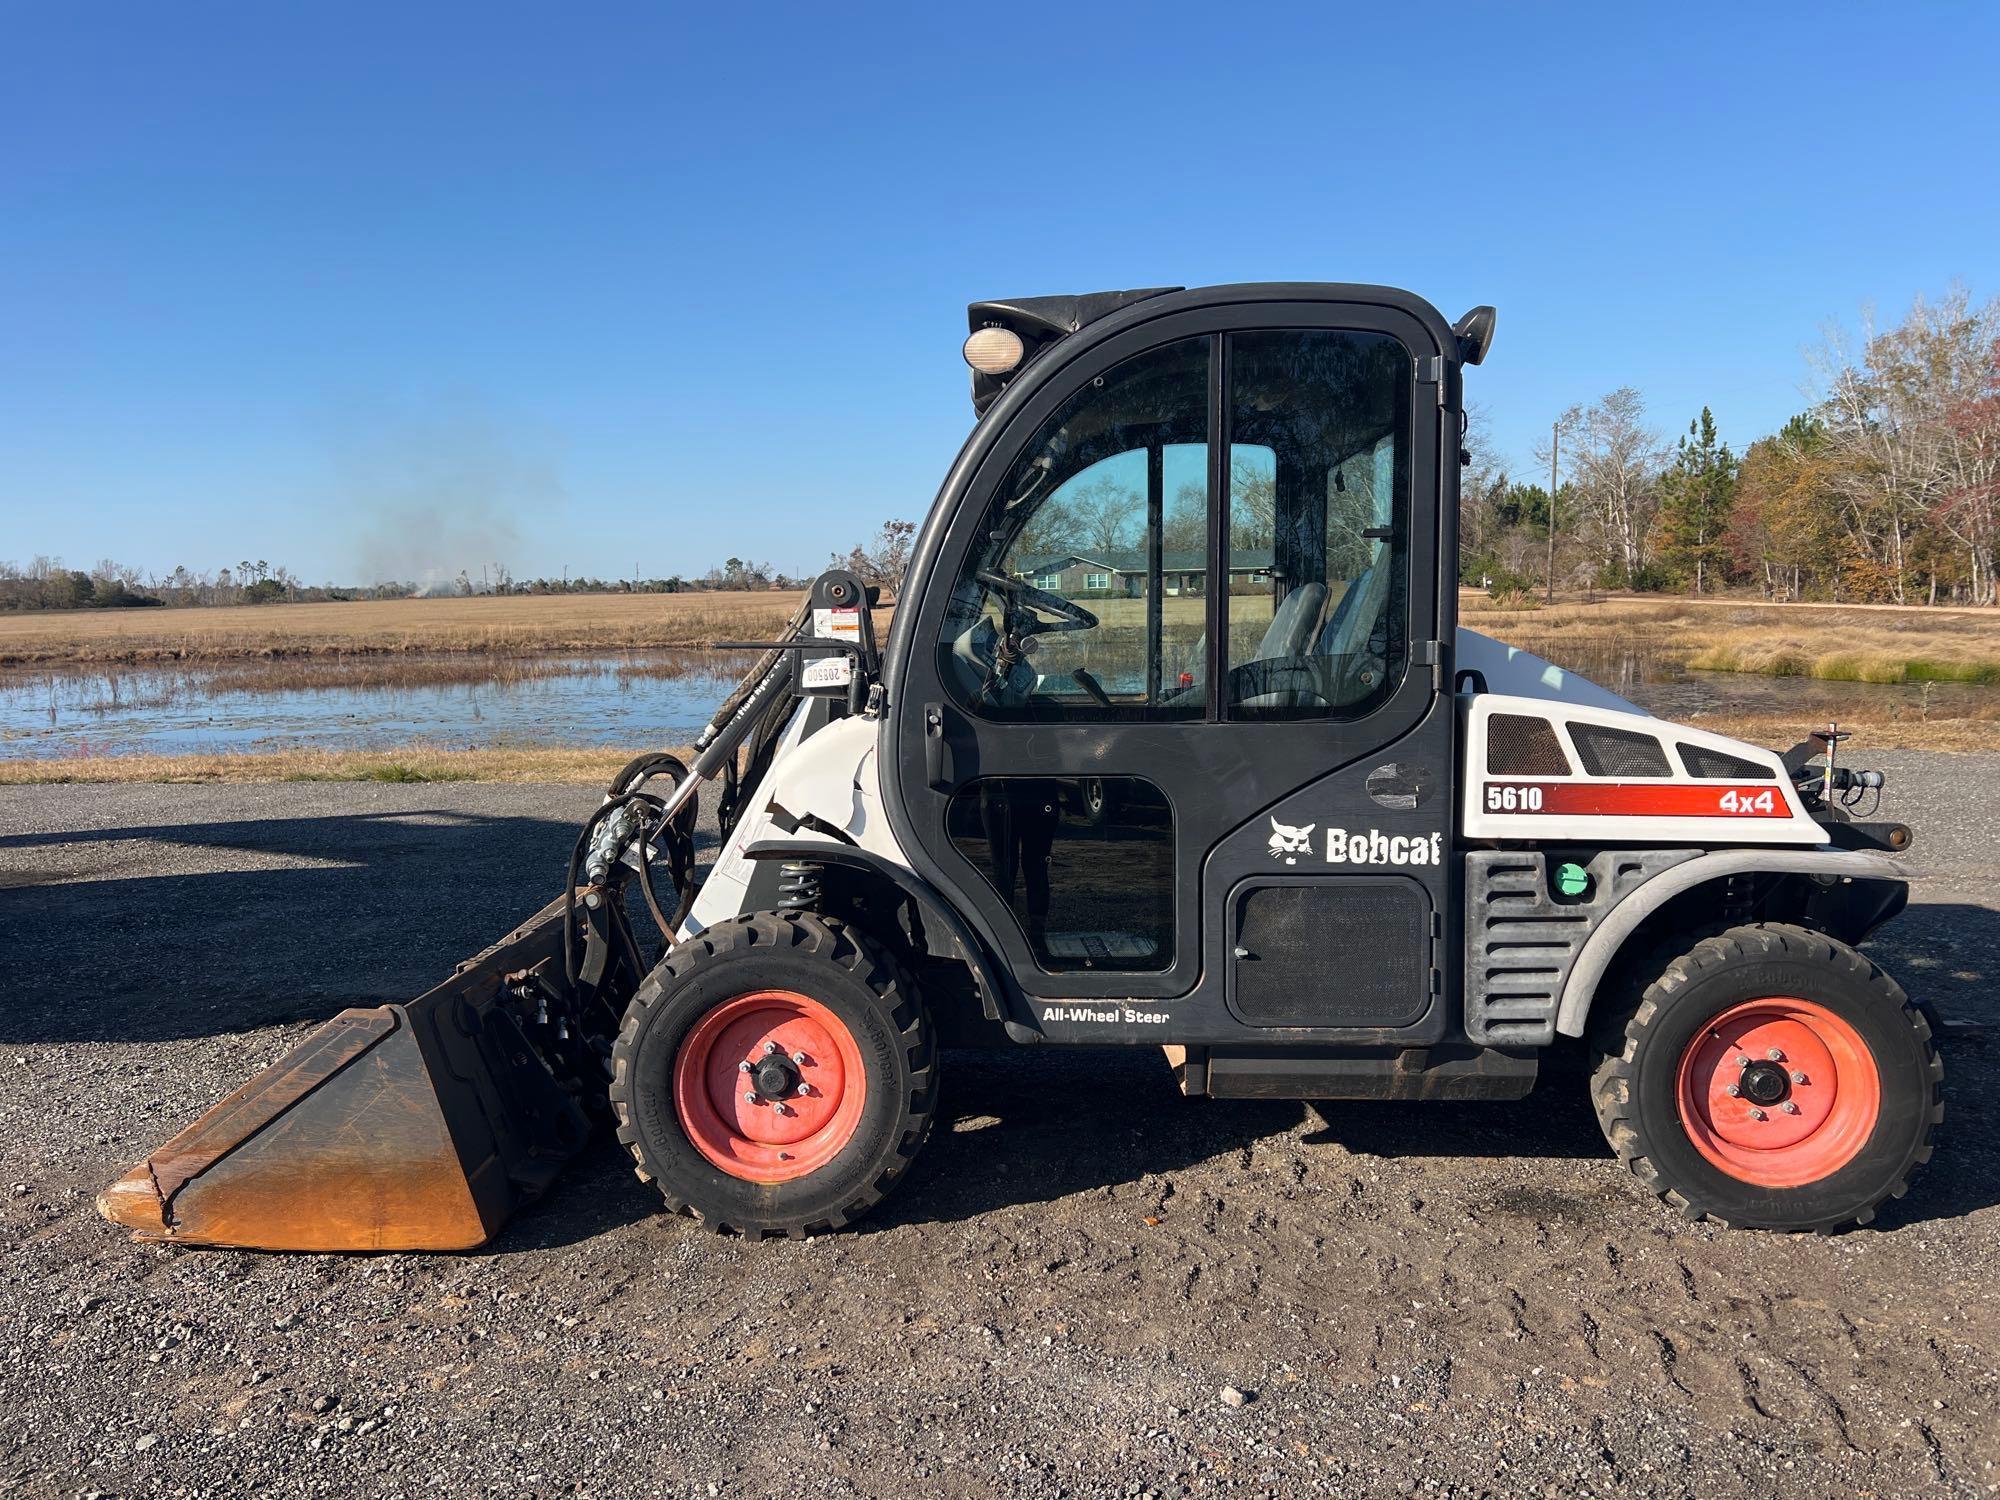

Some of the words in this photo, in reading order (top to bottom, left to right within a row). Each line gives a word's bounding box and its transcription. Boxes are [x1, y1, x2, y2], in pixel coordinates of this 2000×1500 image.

[1487, 786, 1543, 811] 5610
[1718, 789, 1775, 814] 4x4
[1326, 827, 1443, 866] Bobcat
[1042, 1007, 1120, 1023] All-Wheel
[1124, 1009, 1170, 1024] Steer
